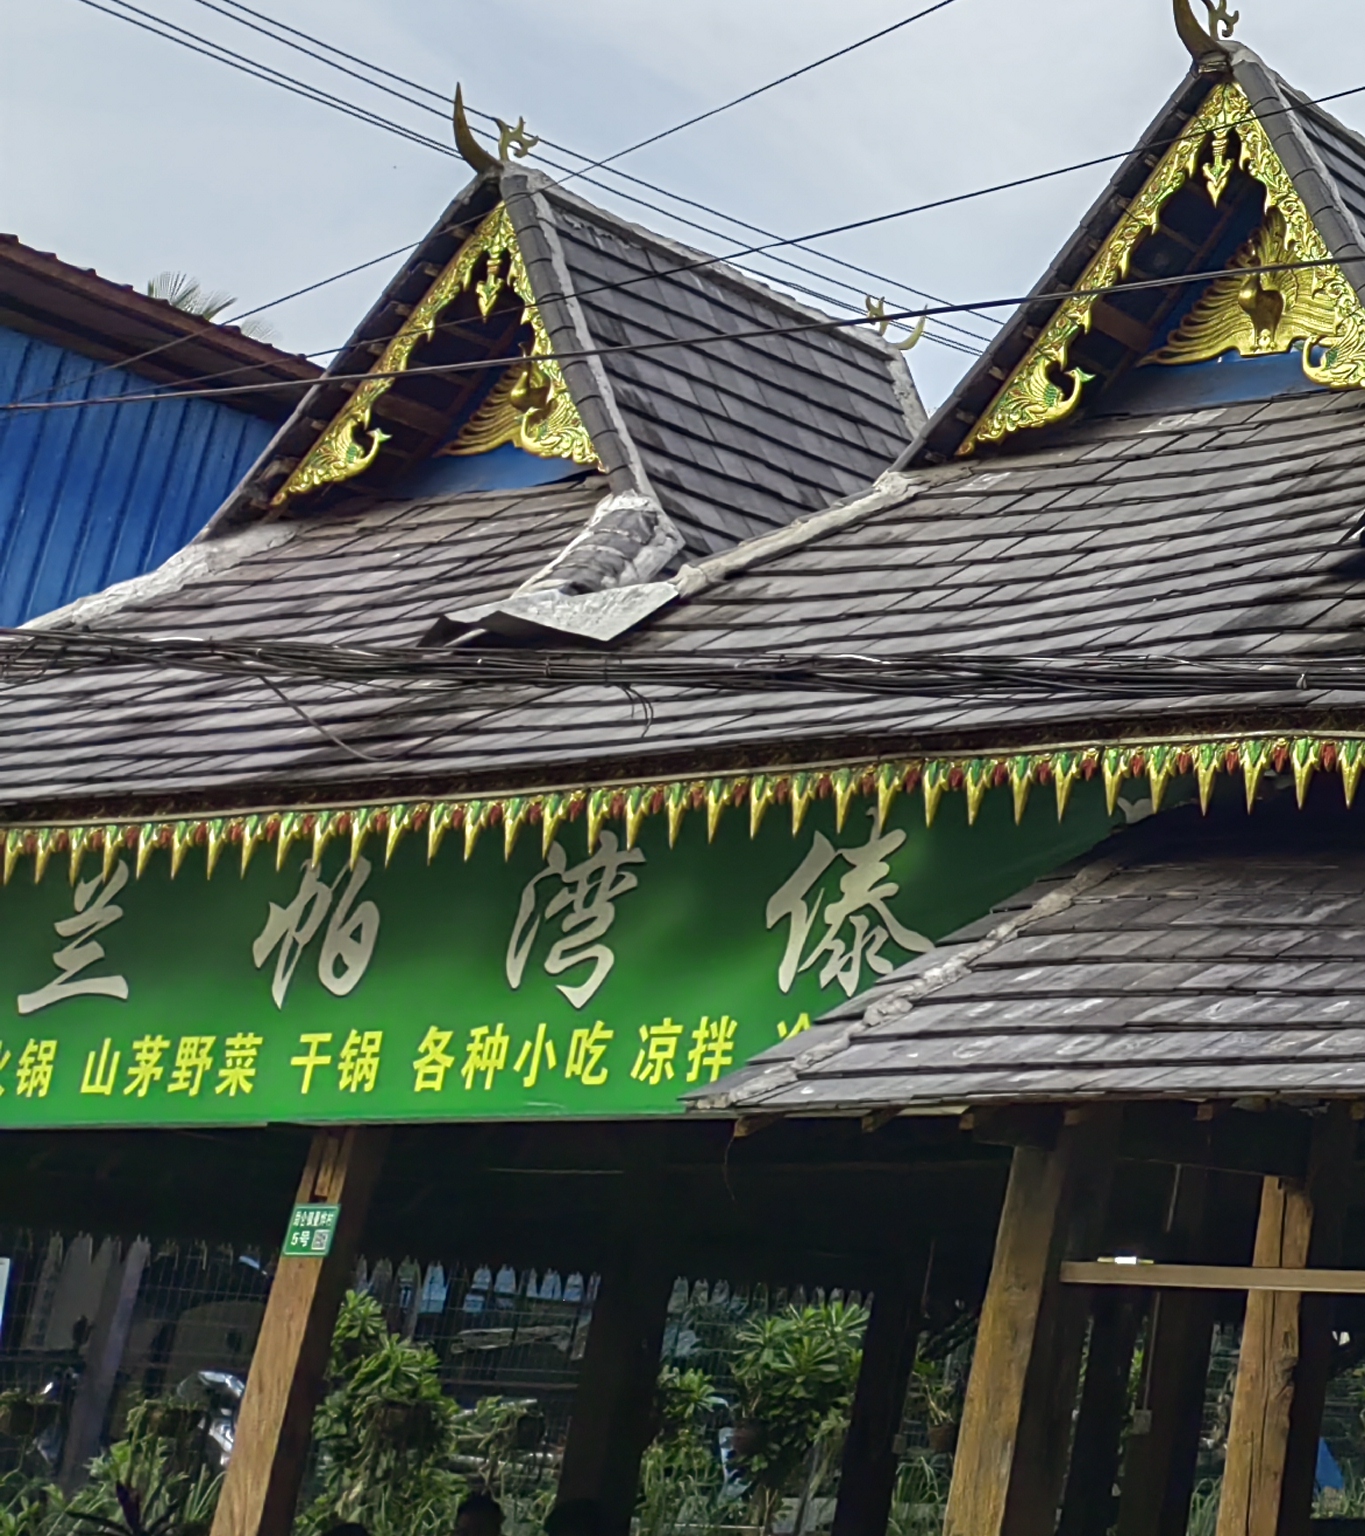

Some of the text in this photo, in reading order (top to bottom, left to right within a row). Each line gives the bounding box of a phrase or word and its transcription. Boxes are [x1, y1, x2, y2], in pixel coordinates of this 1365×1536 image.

[81, 1032, 263, 1097] 山茅野菜
[290, 1030, 383, 1094] 干锅
[413, 1021, 613, 1092] 各种小吃
[630, 1015, 738, 1085] 凉拌
[291, 1231, 310, 1247] 5号
